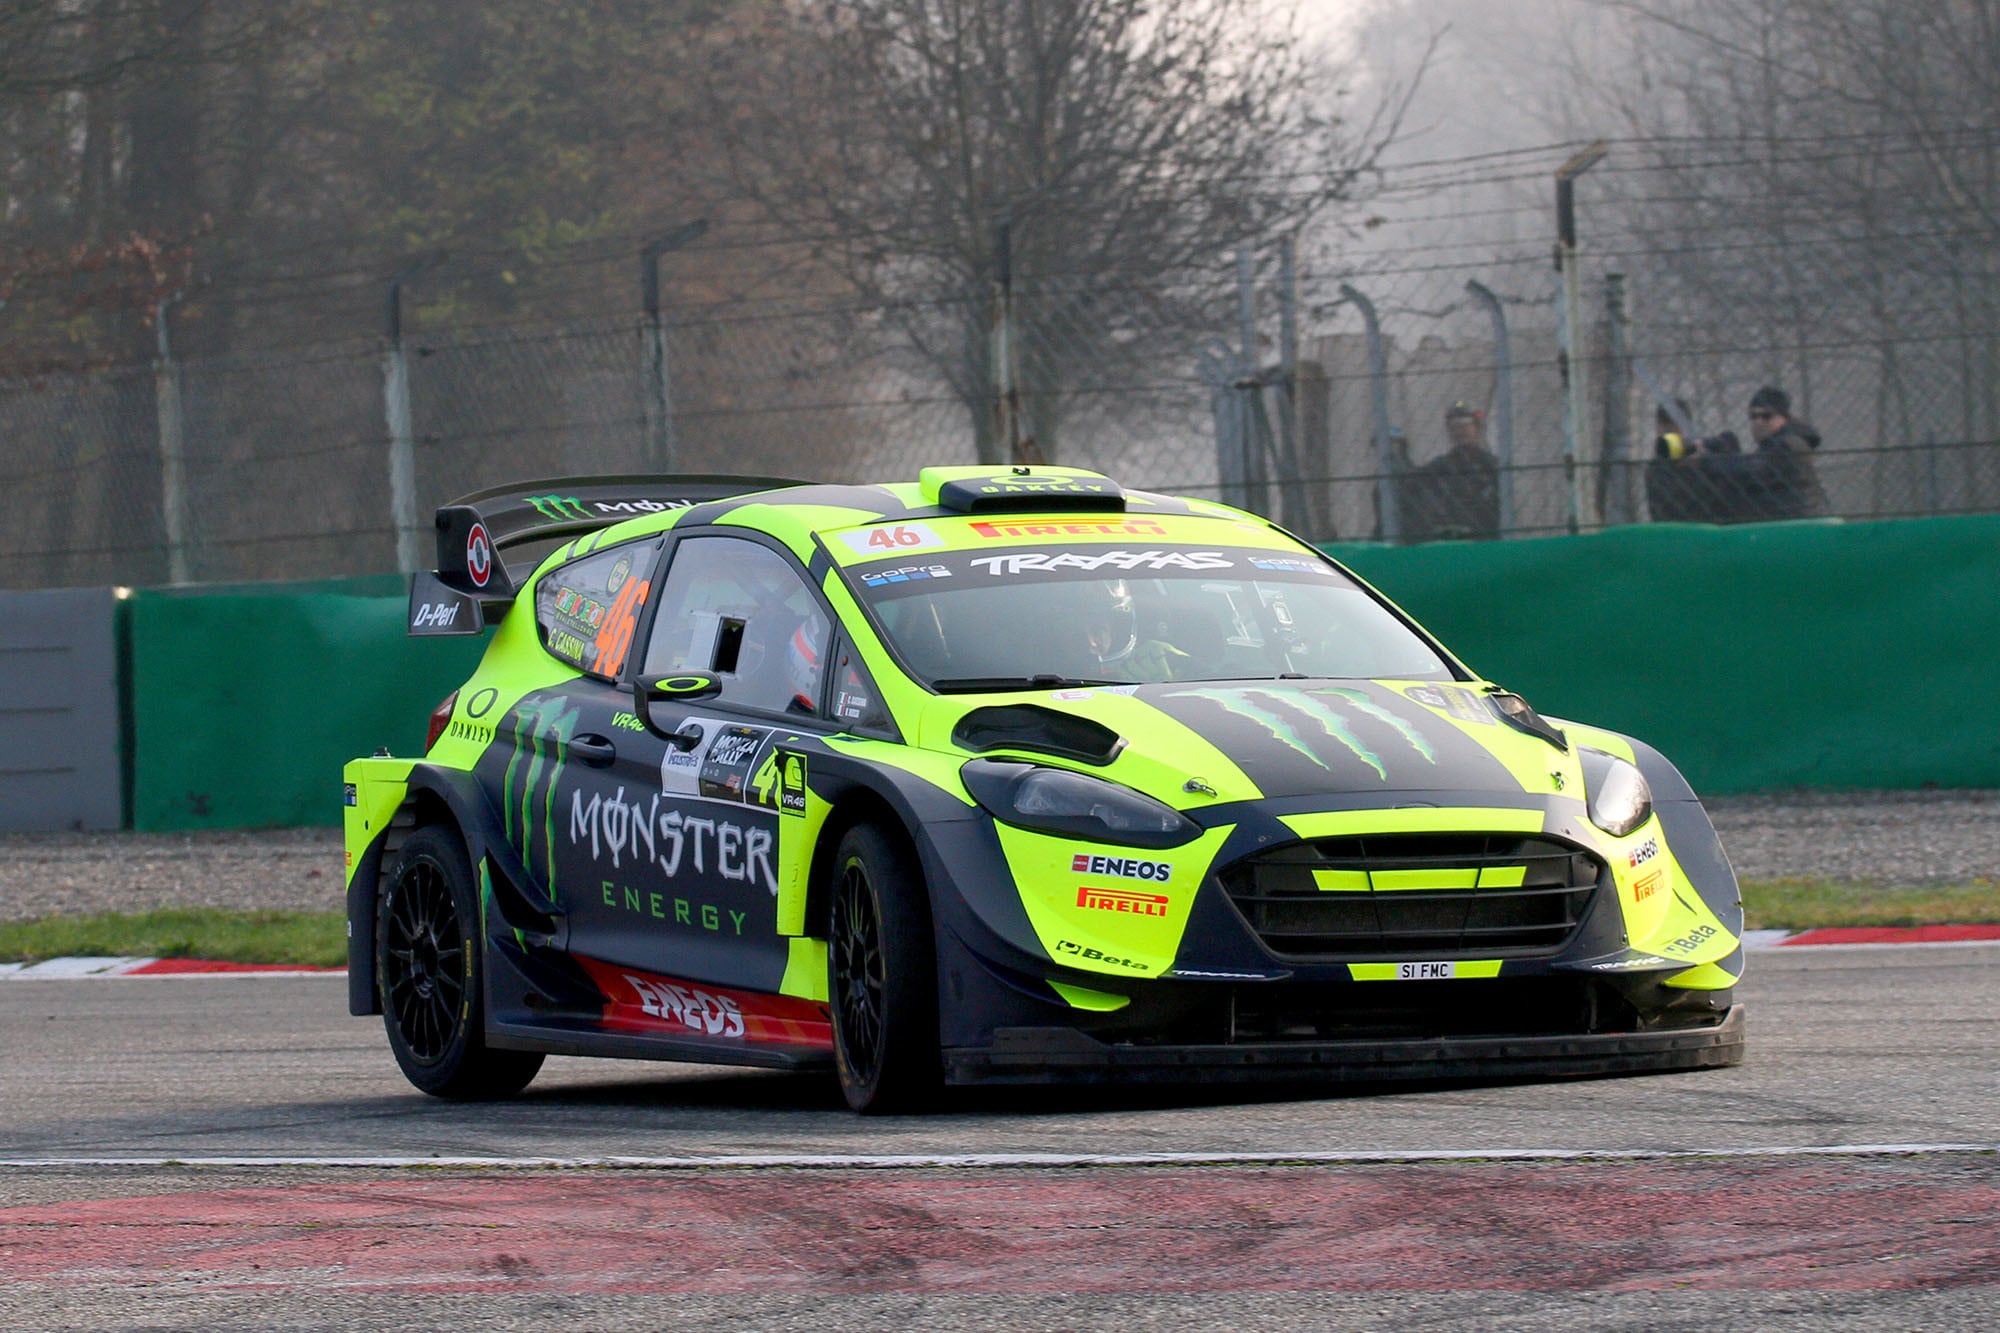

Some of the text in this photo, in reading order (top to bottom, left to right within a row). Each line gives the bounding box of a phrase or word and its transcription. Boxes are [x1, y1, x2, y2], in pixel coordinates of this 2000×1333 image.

[980, 484, 1103, 494] OAKLEY
[868, 526, 921, 548] 46
[968, 518, 1168, 538] PIRELLI
[860, 564, 946, 581] GoPro
[970, 550, 1234, 576] TRAXXAS
[1247, 556, 1325, 569] GoPro
[413, 602, 460, 627] D-Perf
[592, 575, 650, 677] 46
[450, 720, 492, 745] OAKLEY
[570, 786, 779, 897] MONSTER
[1635, 837, 1659, 864] ENEOS
[1091, 856, 1171, 882] ENEOS
[1634, 868, 1665, 903] PIRELLI
[602, 880, 746, 936] ENERGY
[1076, 887, 1169, 917] PIRELLI
[1673, 924, 1718, 955] Beta
[1081, 948, 1149, 970] Beta
[1420, 964, 1449, 977] FMC
[621, 973, 745, 1038] ENEOS
